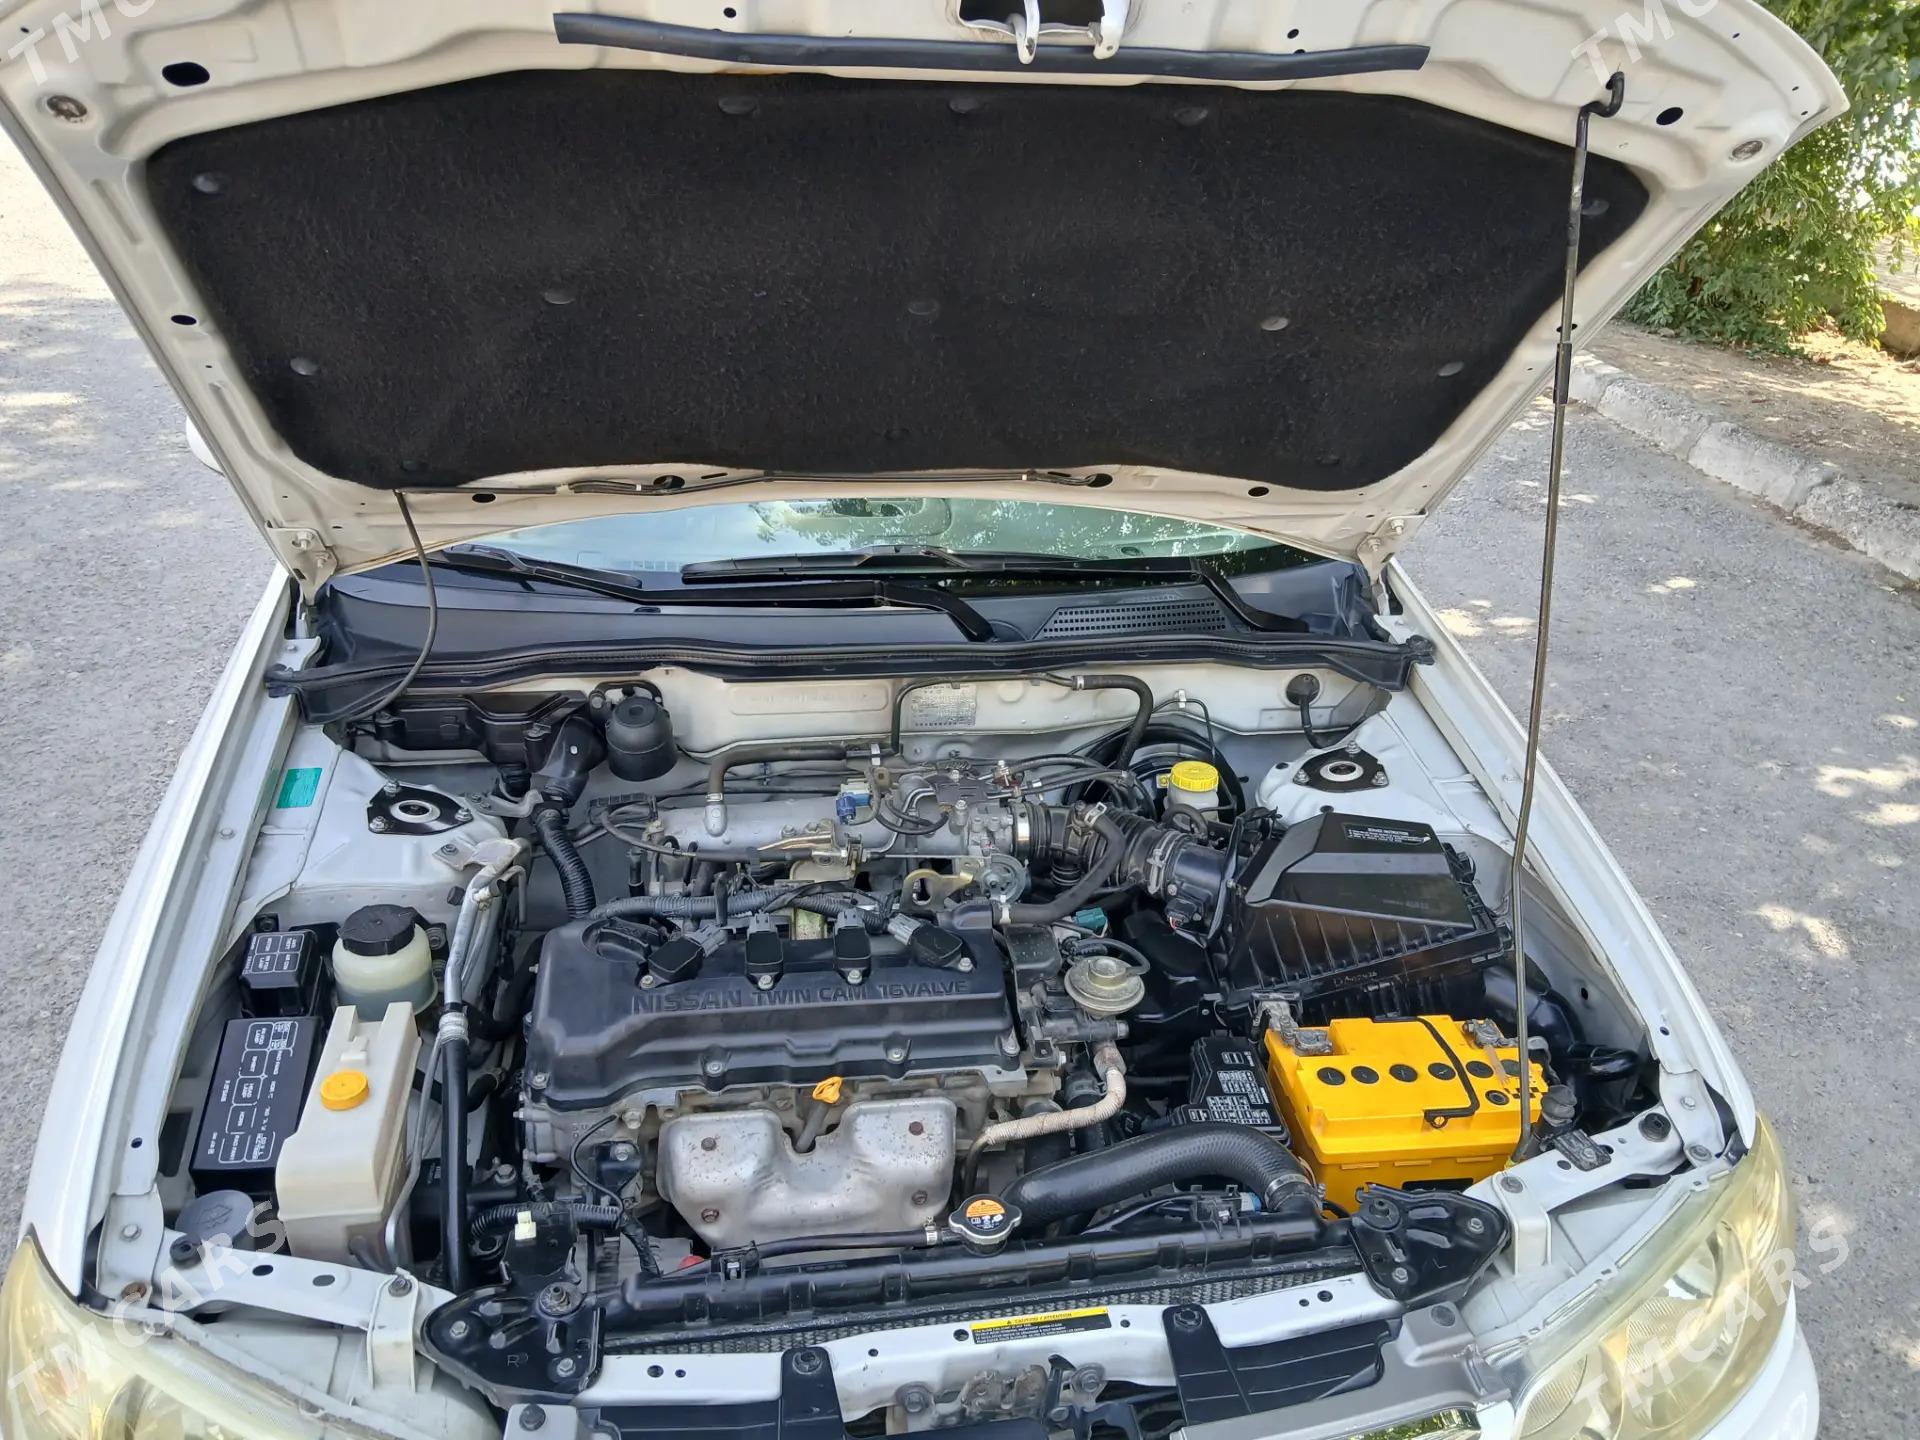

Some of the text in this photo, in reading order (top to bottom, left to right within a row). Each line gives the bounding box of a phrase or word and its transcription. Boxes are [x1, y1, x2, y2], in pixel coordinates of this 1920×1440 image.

[631, 989, 743, 1015] NISSAN
[752, 989, 811, 1007] TWIN
[819, 985, 868, 1003] CAM
